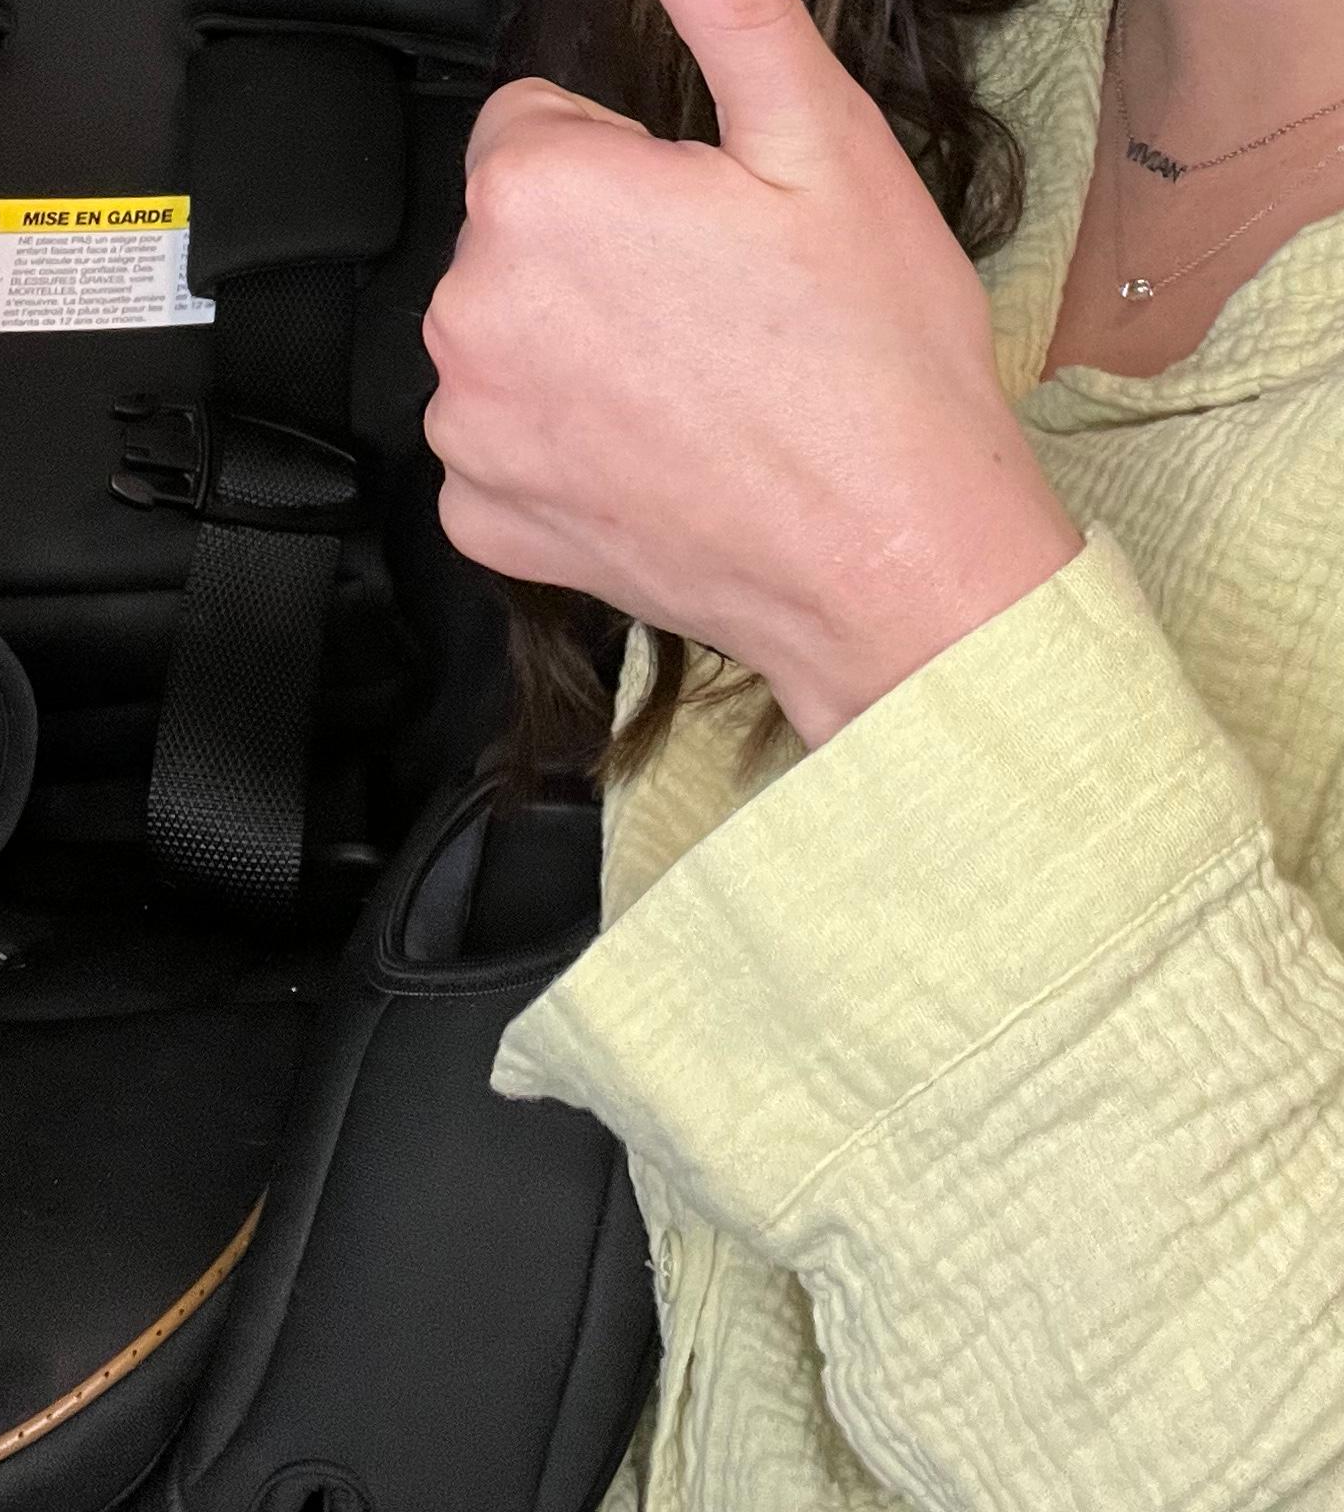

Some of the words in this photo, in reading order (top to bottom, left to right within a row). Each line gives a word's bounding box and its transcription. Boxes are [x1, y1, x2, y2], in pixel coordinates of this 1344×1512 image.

[23, 211, 70, 226] MISE
[76, 211, 101, 225] EN
[107, 208, 174, 225] GARDE
[18, 236, 33, 245] NE
[71, 236, 93, 245] PAS
[10, 276, 76, 286] BLESSURES
[63, 297, 76, 305] La
[1, 317, 40, 328] enfants
[42, 317, 55, 326] de
[60, 316, 71, 325] 12
